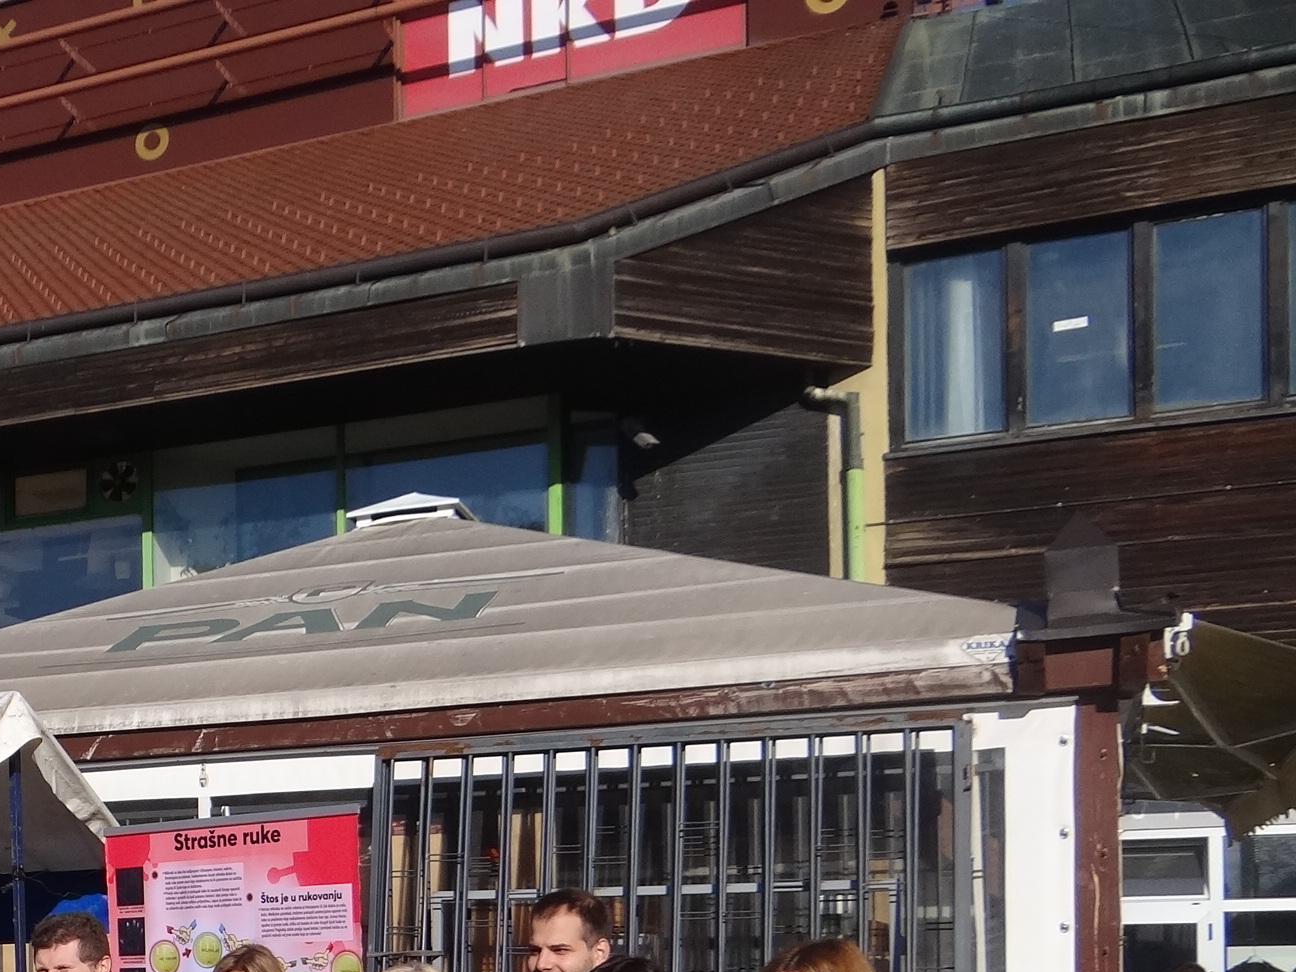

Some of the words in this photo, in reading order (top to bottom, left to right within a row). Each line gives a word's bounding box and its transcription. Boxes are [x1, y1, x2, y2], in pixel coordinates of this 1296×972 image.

[103, 590, 500, 653] PAN
[174, 829, 238, 851] Strašne
[243, 825, 281, 844] ruke
[261, 892, 279, 904] Štos
[280, 893, 289, 905] je
[298, 890, 342, 902] rukovanju
